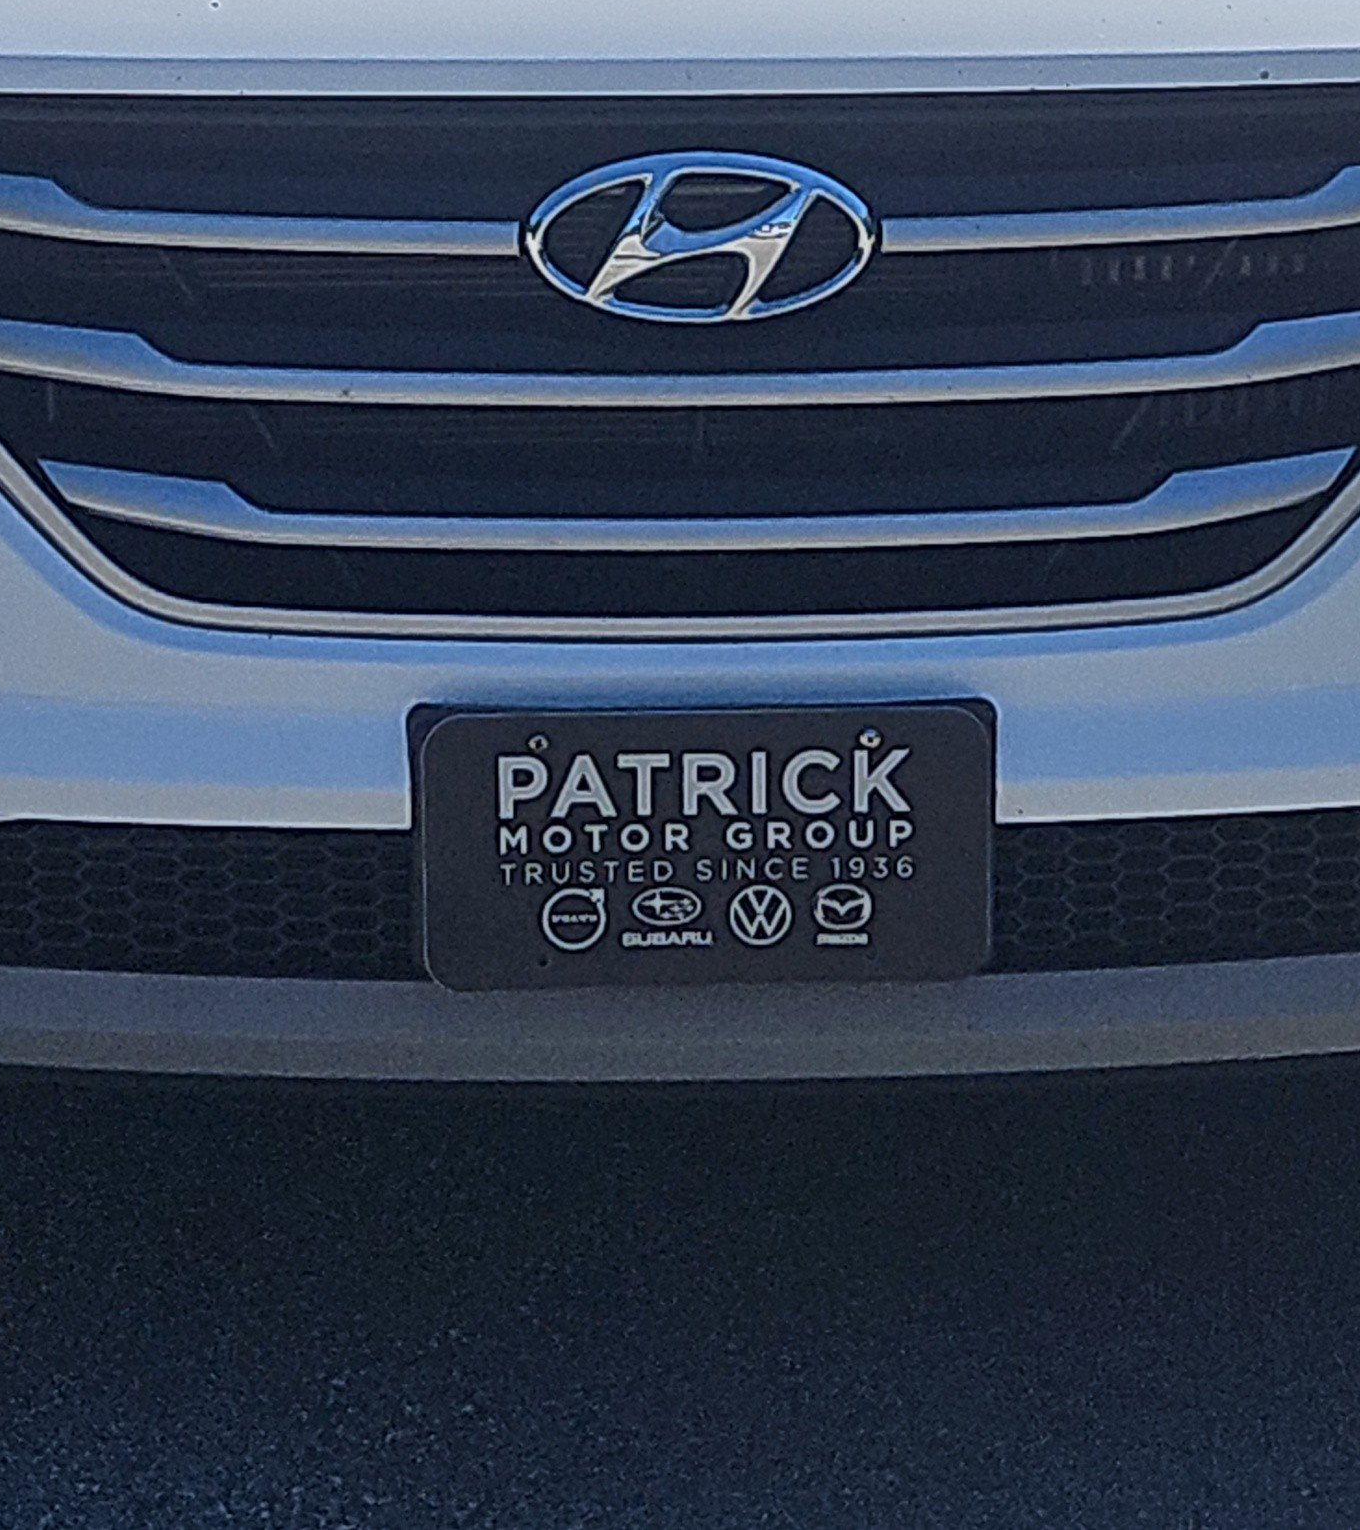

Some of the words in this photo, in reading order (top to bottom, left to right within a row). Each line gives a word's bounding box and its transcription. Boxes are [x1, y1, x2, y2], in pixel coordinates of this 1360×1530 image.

[497, 747, 911, 820] PATRICK
[499, 823, 690, 855] MOTOR
[725, 819, 914, 850] GROUP
[500, 860, 674, 886] TRUSTED
[696, 857, 810, 881] SINCE
[831, 855, 915, 879] 1936
[622, 930, 713, 947] SUBARU
